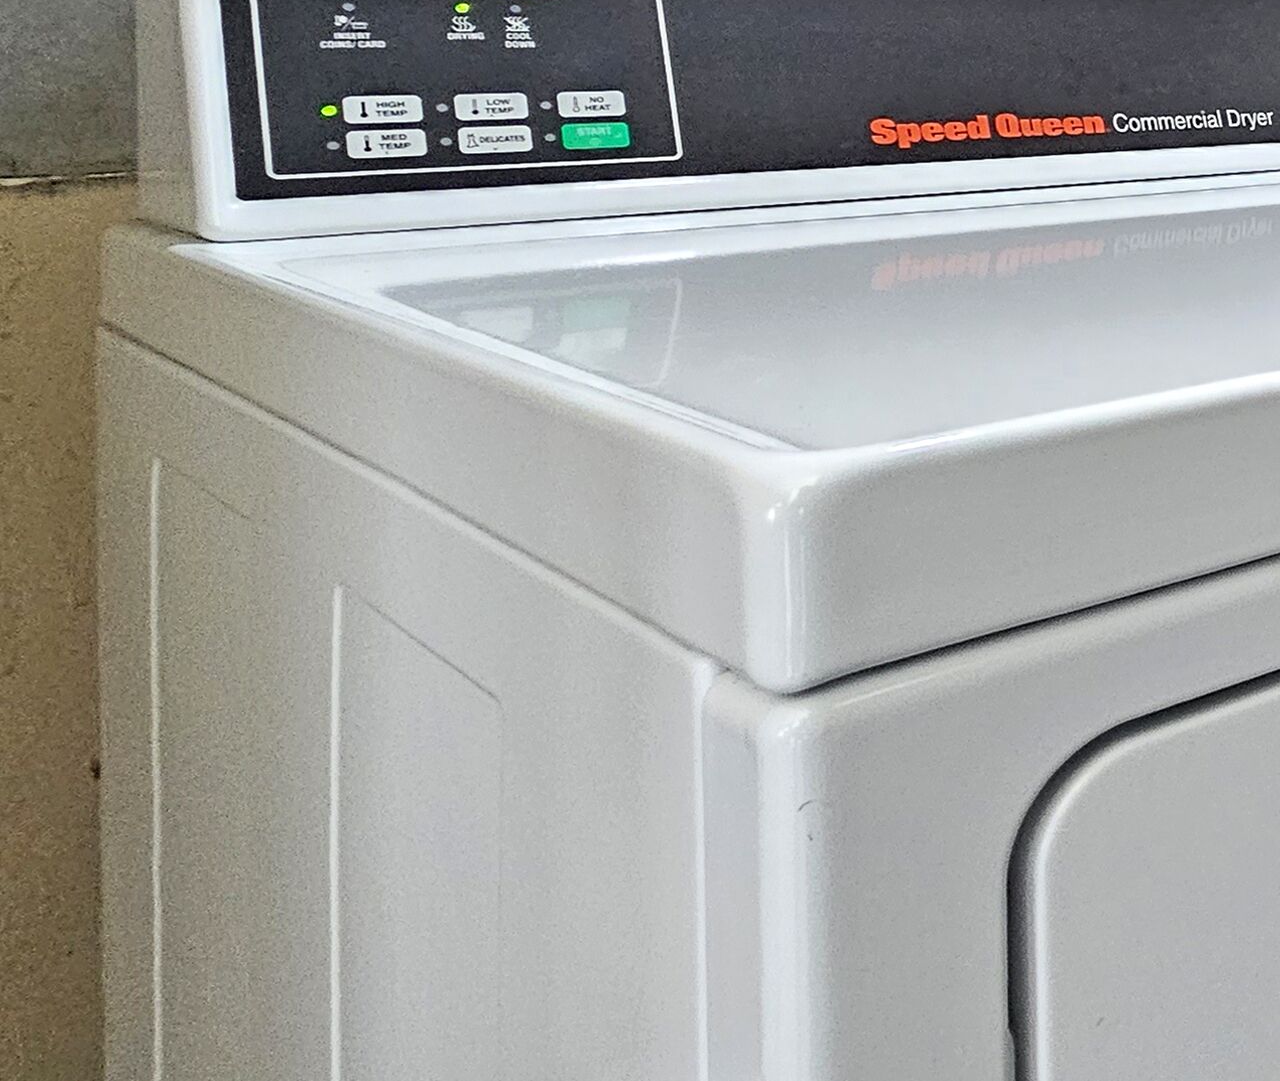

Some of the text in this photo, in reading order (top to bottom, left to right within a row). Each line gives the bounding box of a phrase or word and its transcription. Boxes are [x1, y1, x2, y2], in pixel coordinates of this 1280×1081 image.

[505, 32, 532, 40] COOL
[505, 41, 536, 49] DOWN
[486, 98, 512, 106] LOW
[485, 106, 515, 115] TEMP
[584, 103, 612, 111] HEAT
[375, 109, 408, 118] TEMP
[576, 127, 612, 136] START
[869, 109, 1274, 148] Speed Queen Commercial Dryer
[380, 133, 407, 141] MED
[479, 135, 526, 143] DELICATES
[378, 142, 412, 150] TEMP
